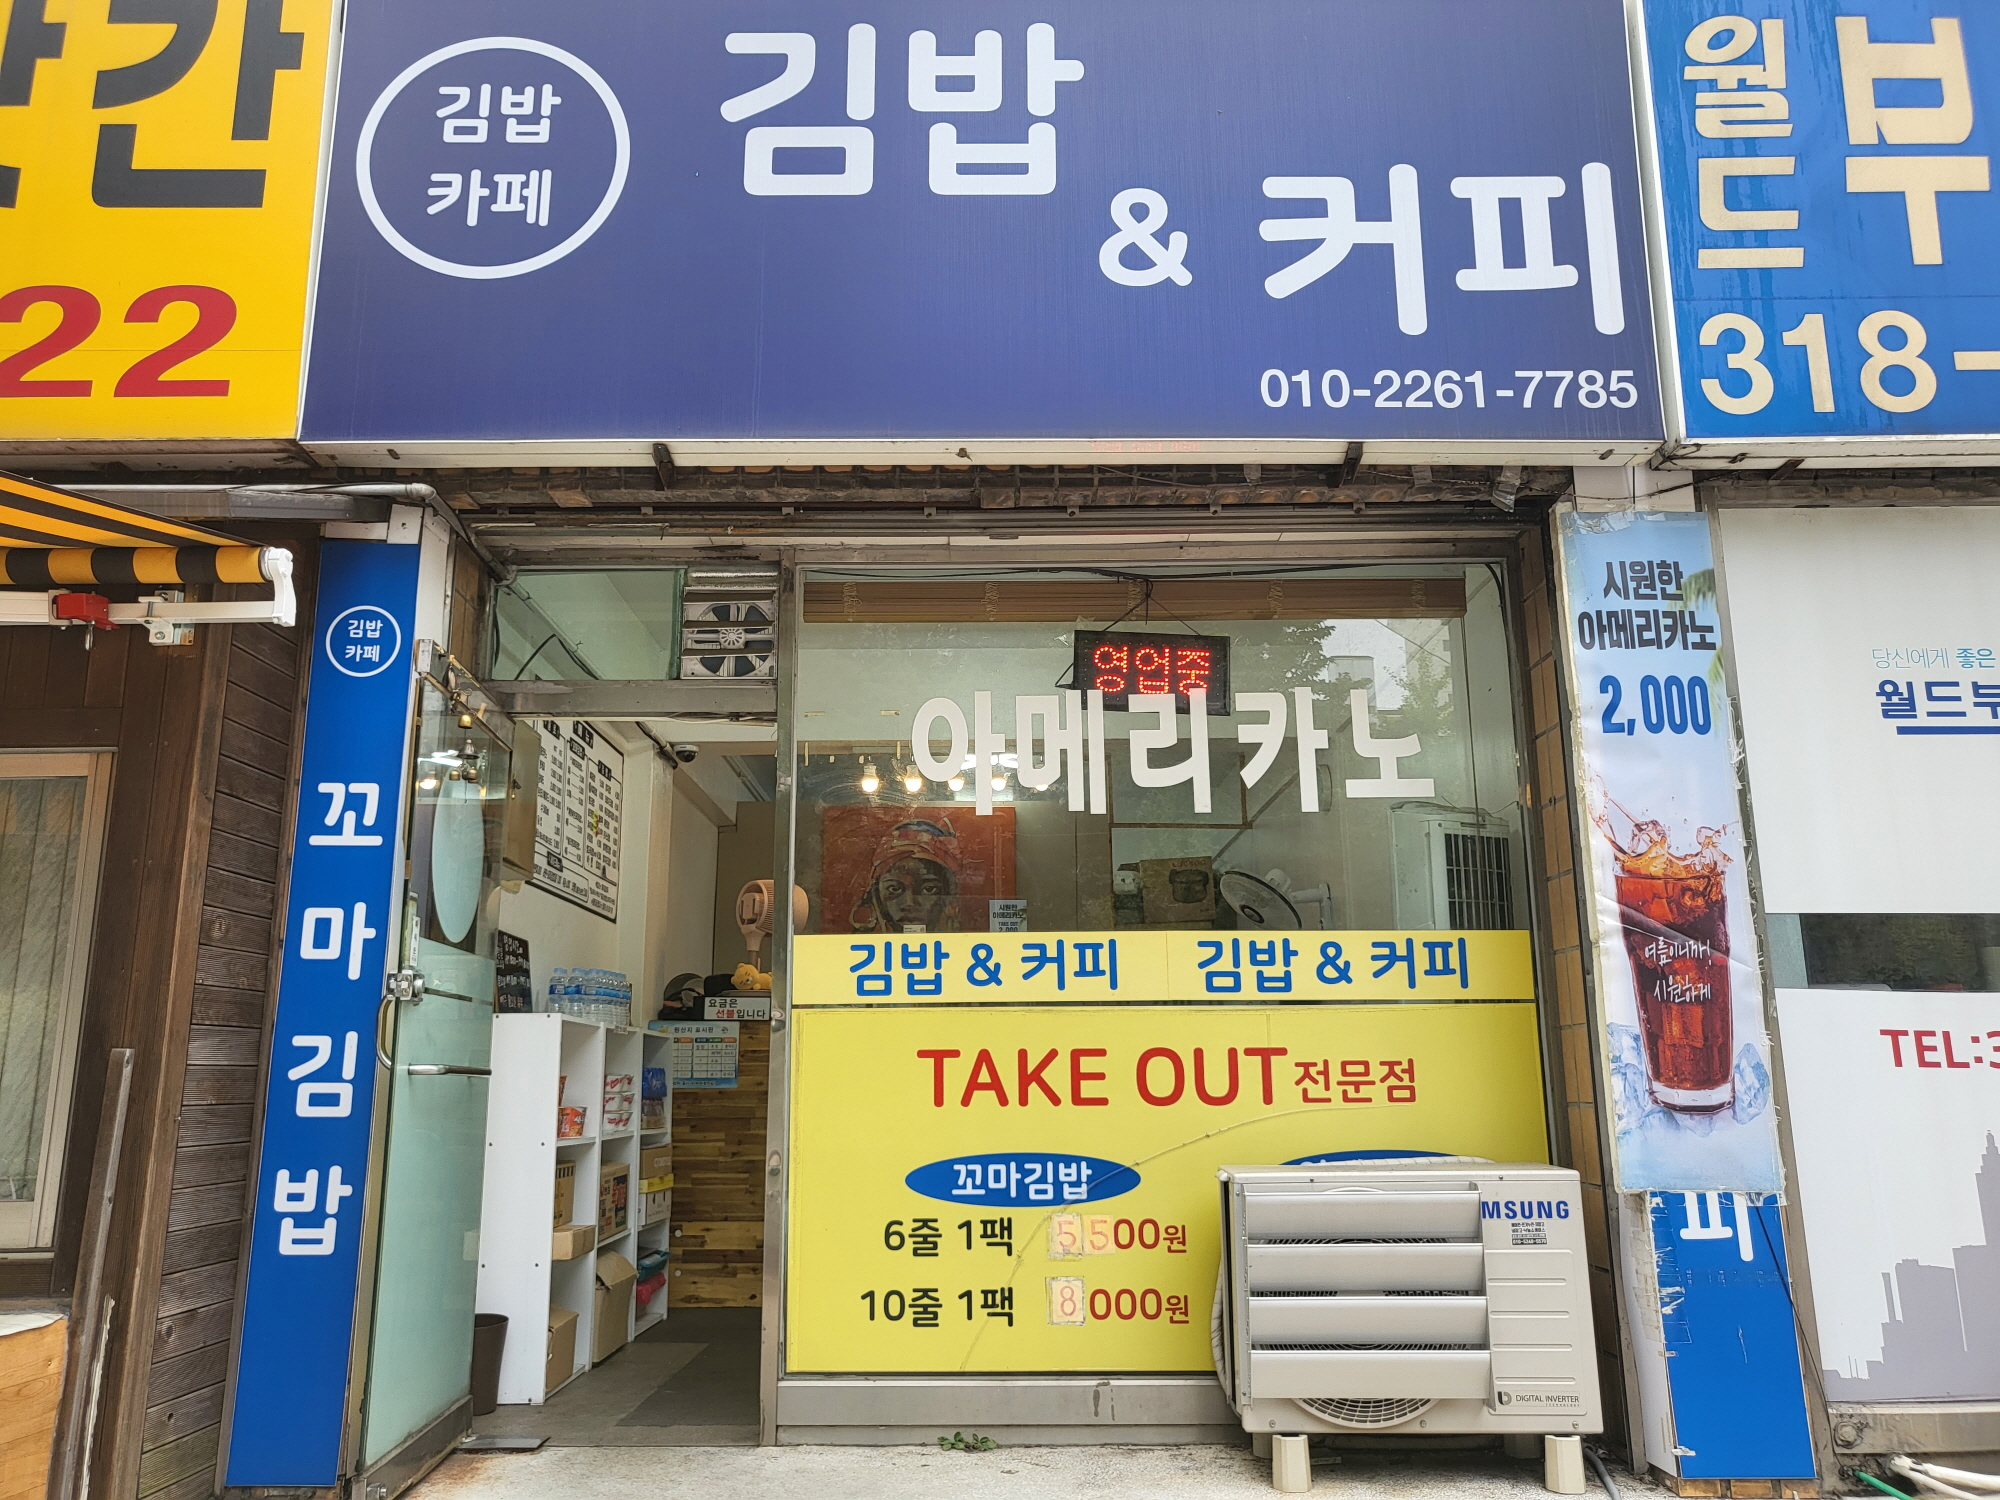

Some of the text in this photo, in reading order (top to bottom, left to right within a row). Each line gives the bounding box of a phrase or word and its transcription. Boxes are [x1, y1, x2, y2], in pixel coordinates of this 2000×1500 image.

[436, 83, 562, 144] 김밥
[720, 23, 1085, 195] 김밥
[1683, 15, 1804, 269] 월드
[1835, 16, 1991, 265] 부
[426, 168, 552, 226] 카페
[1099, 162, 1625, 335] & 커피
[1260, 368, 1638, 408] 010-2261-7785
[1603, 560, 1684, 600] 시원한
[348, 619, 383, 638] 김밥
[1577, 609, 1717, 651] 아메리카노
[345, 645, 380, 662] 카페
[1094, 646, 1209, 695] 영업중
[1872, 647, 1997, 669] 당신에게 좋은
[1600, 674, 1712, 736] 2,000
[912, 686, 1435, 816] 아메리카노
[849, 939, 1118, 996] 김밥 & 커피
[1197, 938, 1469, 993] 김밥 & 커피
[1644, 936, 1712, 967] 여름이니까!
[708, 998, 738, 1008] 요금은
[1653, 974, 1711, 1003] 시원하게
[274, 782, 383, 1256] 꼬마김밥
[716, 1009, 766, 1019] 선불입니다
[916, 1046, 1417, 1107] TAKE OUT 전문점
[951, 1160, 1093, 1200] 꼬마김밥
[884, 1217, 942, 1257] 6줄
[957, 1216, 1013, 1257] 1팩
[860, 1288, 943, 1328] 10줄
[957, 1286, 1014, 1327] 1팩
[1516, 1394, 1579, 1403] DIGITAL INVERTER
